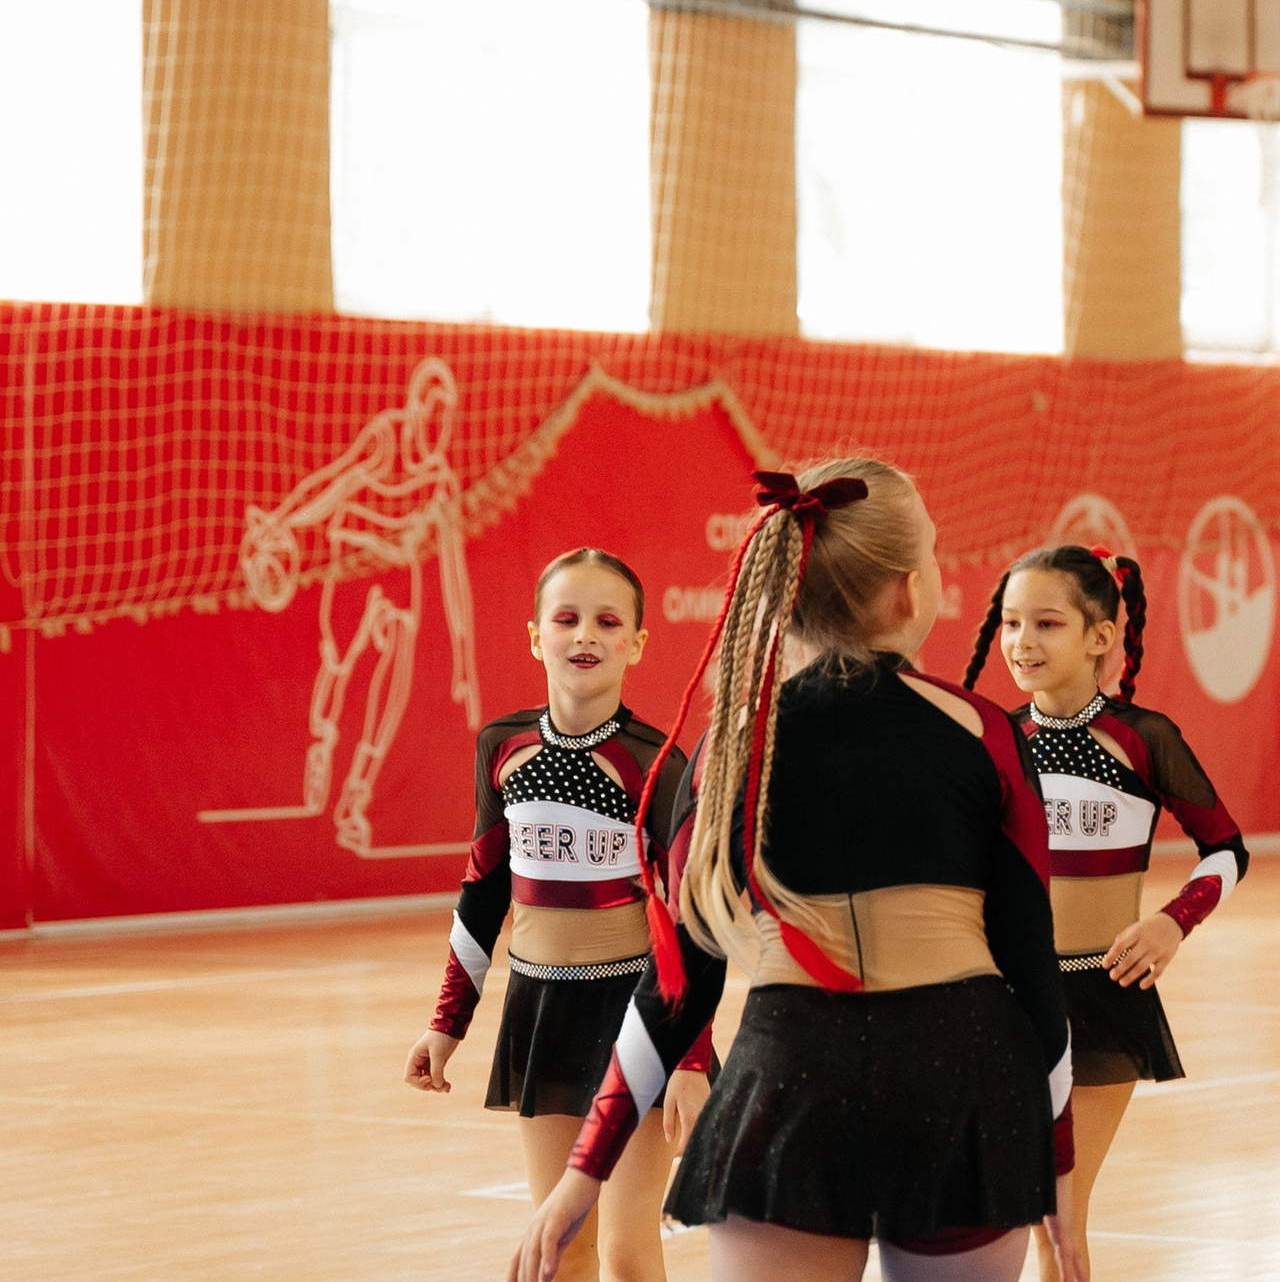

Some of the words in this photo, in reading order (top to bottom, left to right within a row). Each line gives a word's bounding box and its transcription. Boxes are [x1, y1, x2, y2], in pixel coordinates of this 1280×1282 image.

[1079, 799, 1118, 836] UP
[509, 819, 580, 863] EER
[586, 828, 628, 866] UP
